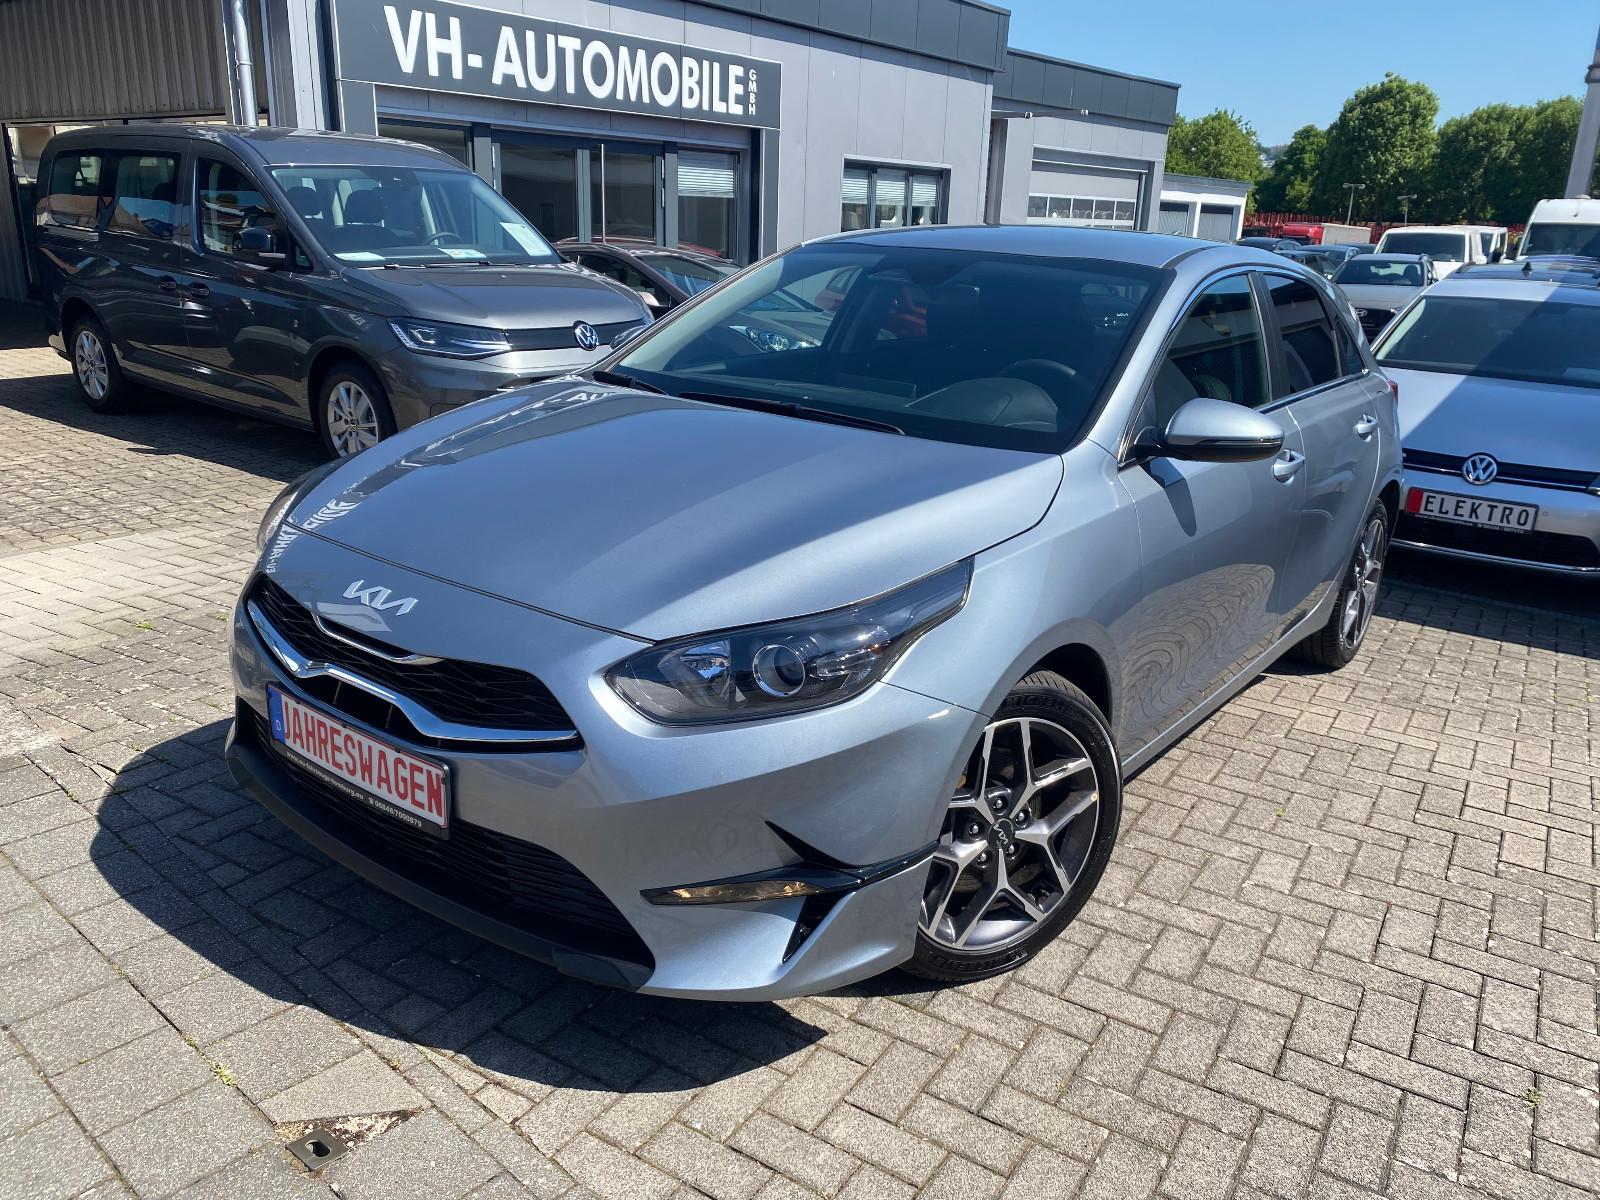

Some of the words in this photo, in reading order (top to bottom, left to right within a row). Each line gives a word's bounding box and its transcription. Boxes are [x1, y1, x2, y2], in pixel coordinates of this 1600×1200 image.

[384, 5, 483, 80] VH-
[491, 26, 745, 116] AUTOMOBILE
[748, 68, 757, 116] GMBH
[1423, 495, 1530, 527] ELEKTRO
[285, 702, 443, 817] JAHRESWAGEN
